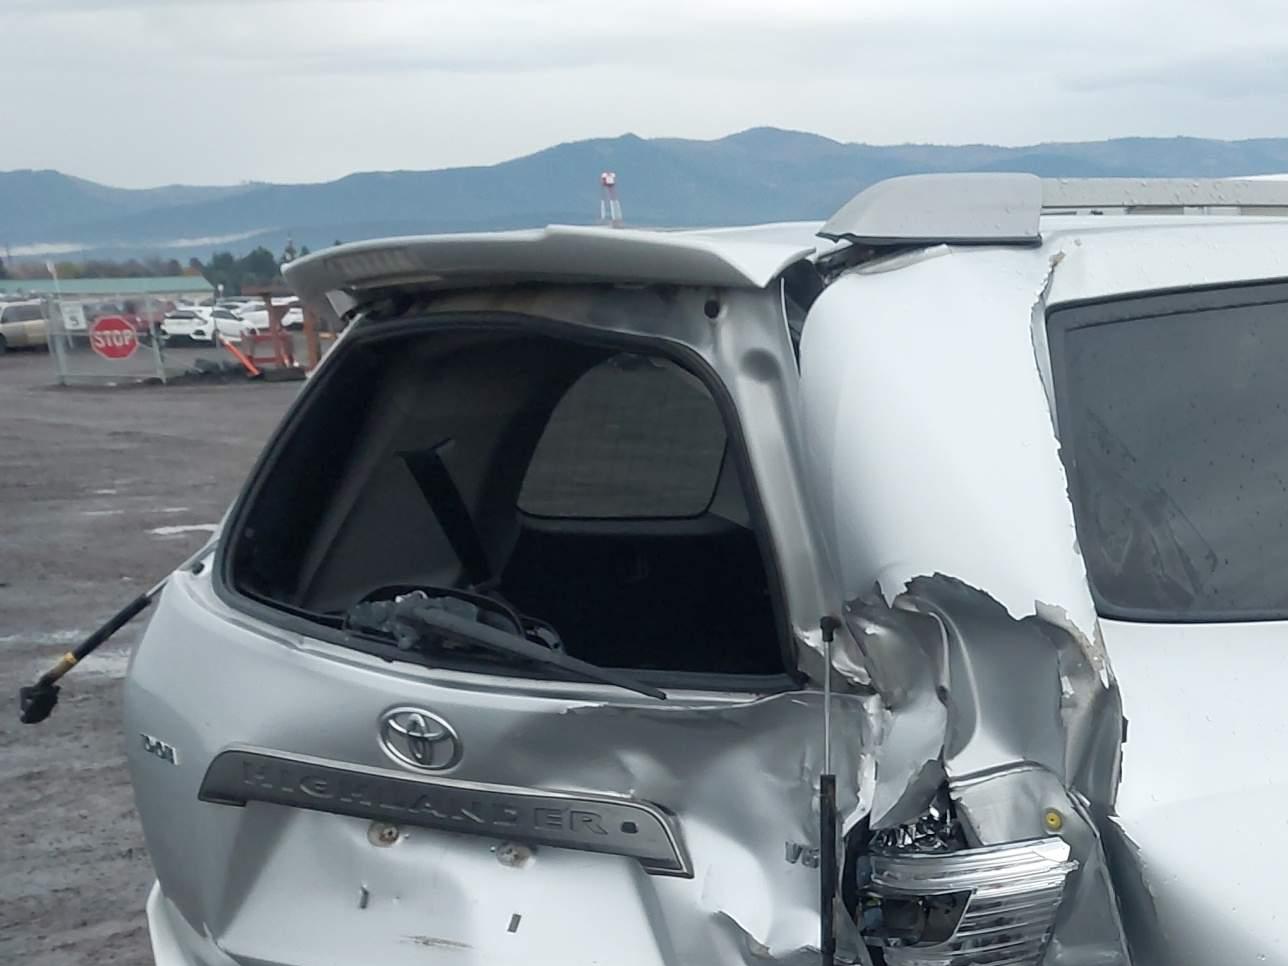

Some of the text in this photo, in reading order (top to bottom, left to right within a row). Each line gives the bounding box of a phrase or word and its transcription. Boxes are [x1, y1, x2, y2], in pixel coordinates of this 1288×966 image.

[94, 329, 133, 348] STOP
[239, 759, 609, 836] HIGHLANDER
[784, 840, 820, 869] V6
